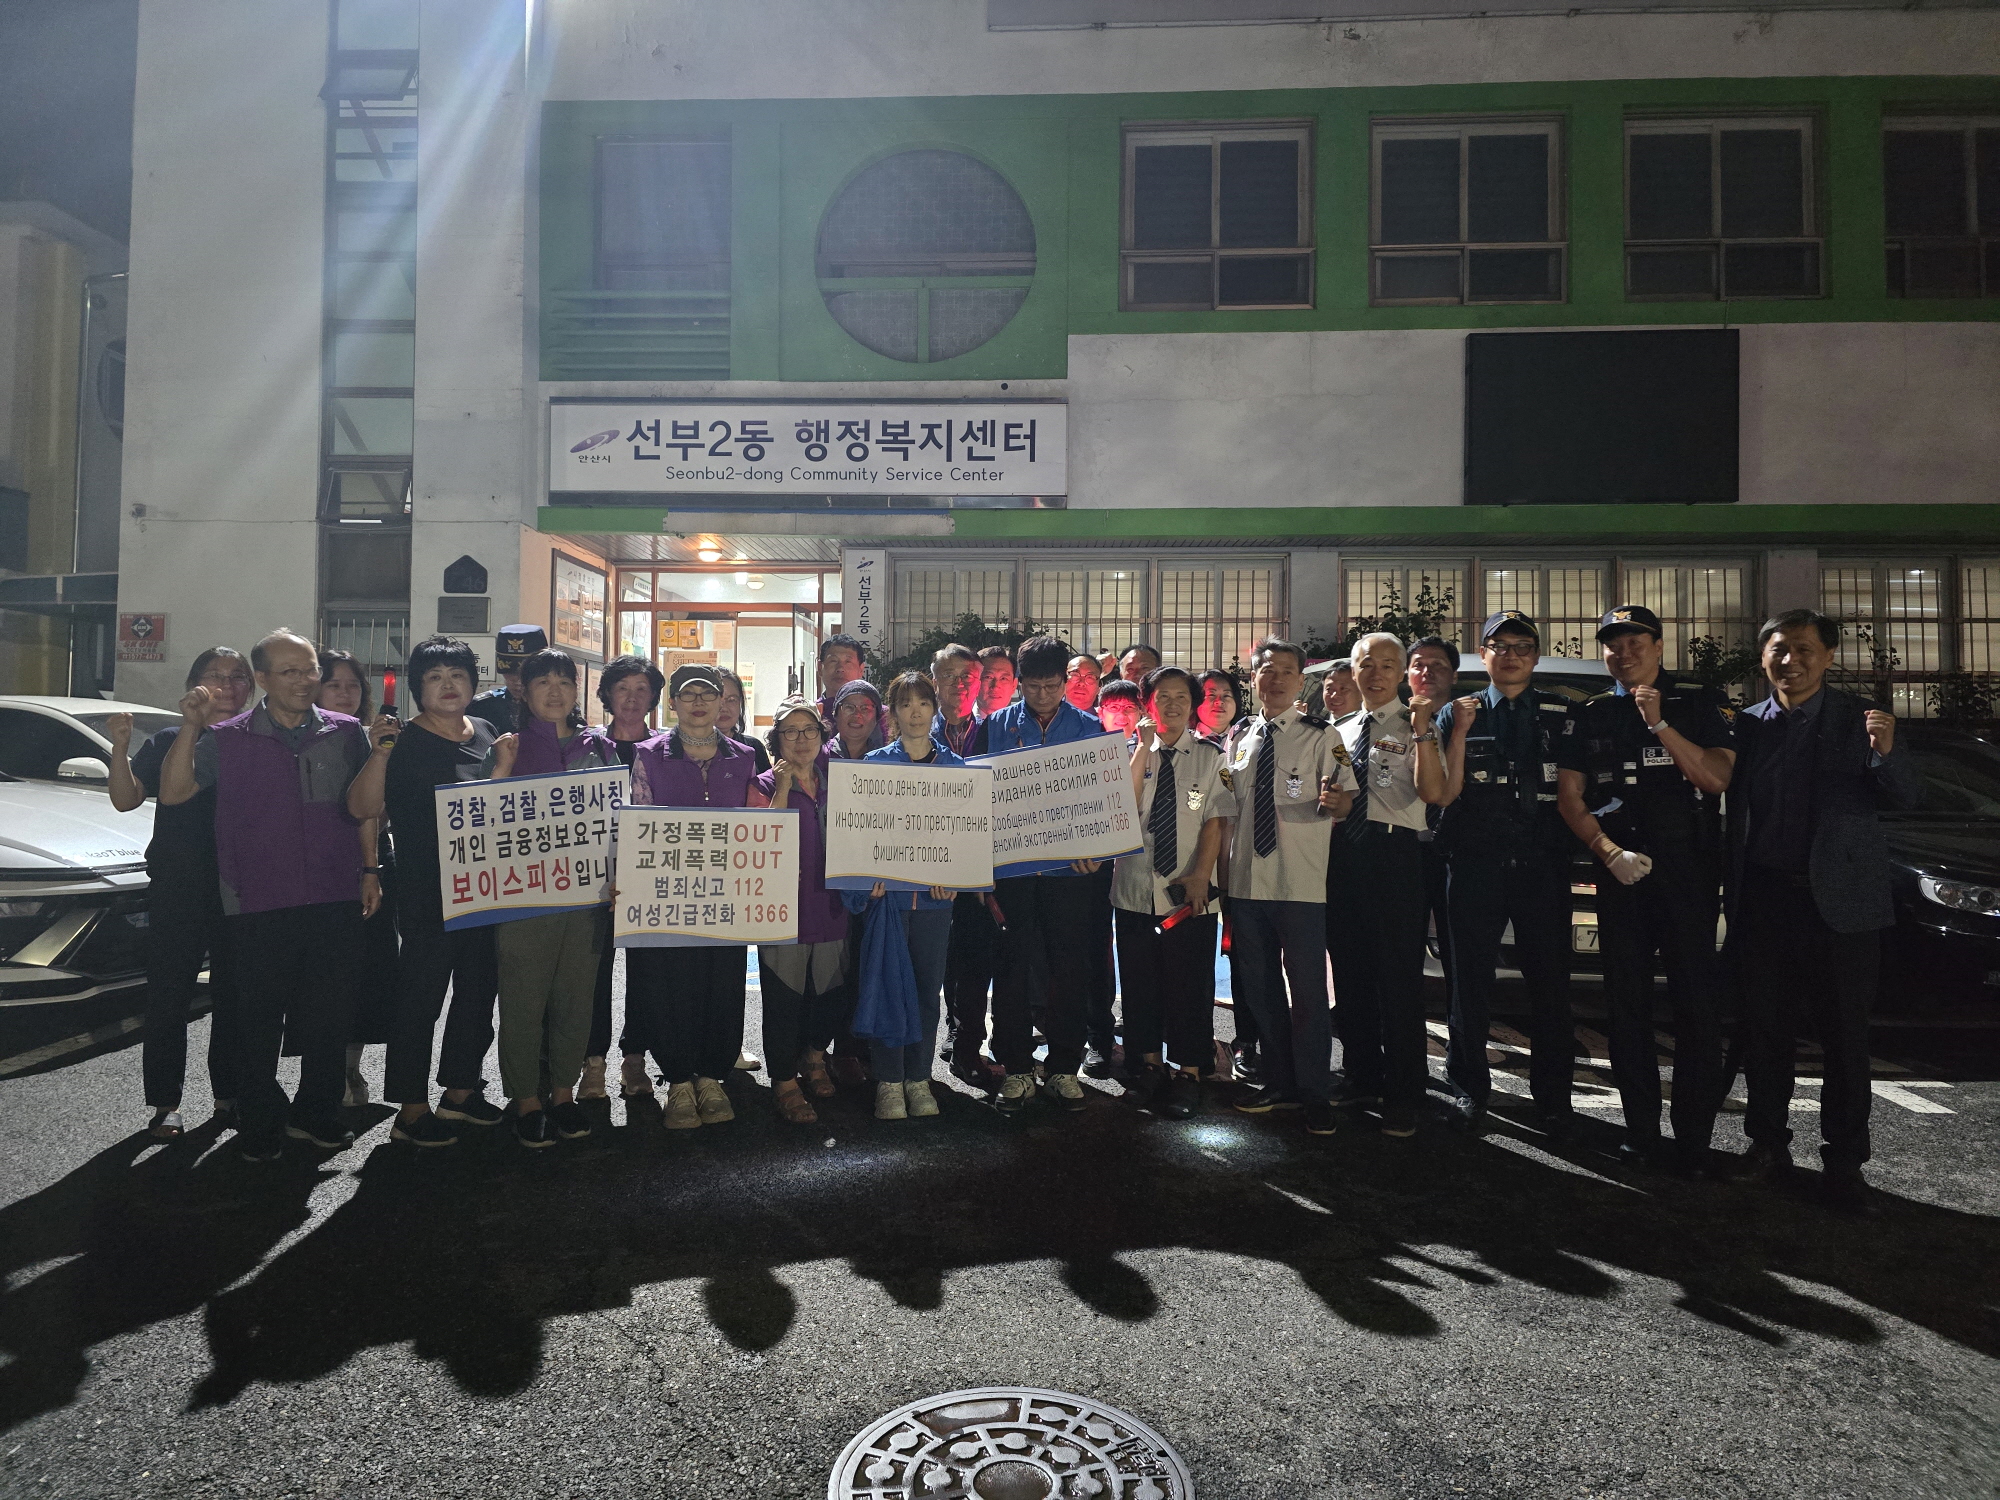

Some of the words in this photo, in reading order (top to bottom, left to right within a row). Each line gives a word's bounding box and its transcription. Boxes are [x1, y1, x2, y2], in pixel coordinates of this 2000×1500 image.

[625, 419, 775, 462] 선부2동
[794, 419, 1037, 463] 행정복지센터
[578, 454, 612, 464] 안산시
[665, 466, 784, 484] Seonbu2-dong
[790, 467, 878, 484] Community
[886, 467, 943, 482] Service
[950, 467, 1005, 482] Center
[857, 575, 873, 635] 선부2동
[1044, 751, 1097, 773] насилие
[1099, 743, 1120, 762] out
[851, 773, 886, 798] Запрос
[887, 780, 893, 796] о
[895, 779, 932, 800] деньгах
[933, 780, 939, 798] и
[940, 777, 974, 799] личной
[1045, 772, 1098, 795] насилия
[1103, 764, 1123, 783] out
[835, 808, 895, 832] информации
[905, 813, 922, 831] это
[924, 814, 989, 835] преступление
[1038, 811, 1043, 823] о
[1045, 798, 1104, 823] преступлении
[1106, 791, 1122, 811] 112
[449, 833, 487, 865] 개인
[873, 841, 915, 864] фишинга
[917, 845, 952, 863] голоса.
[992, 832, 1023, 854] енский
[1024, 824, 1074, 848] экстренный
[452, 856, 617, 905] 보이스피싱입니
[654, 875, 726, 899] 범죄신고
[734, 877, 764, 896] 112
[626, 902, 736, 927] 여성긴급전화
[744, 903, 789, 923] 1366
